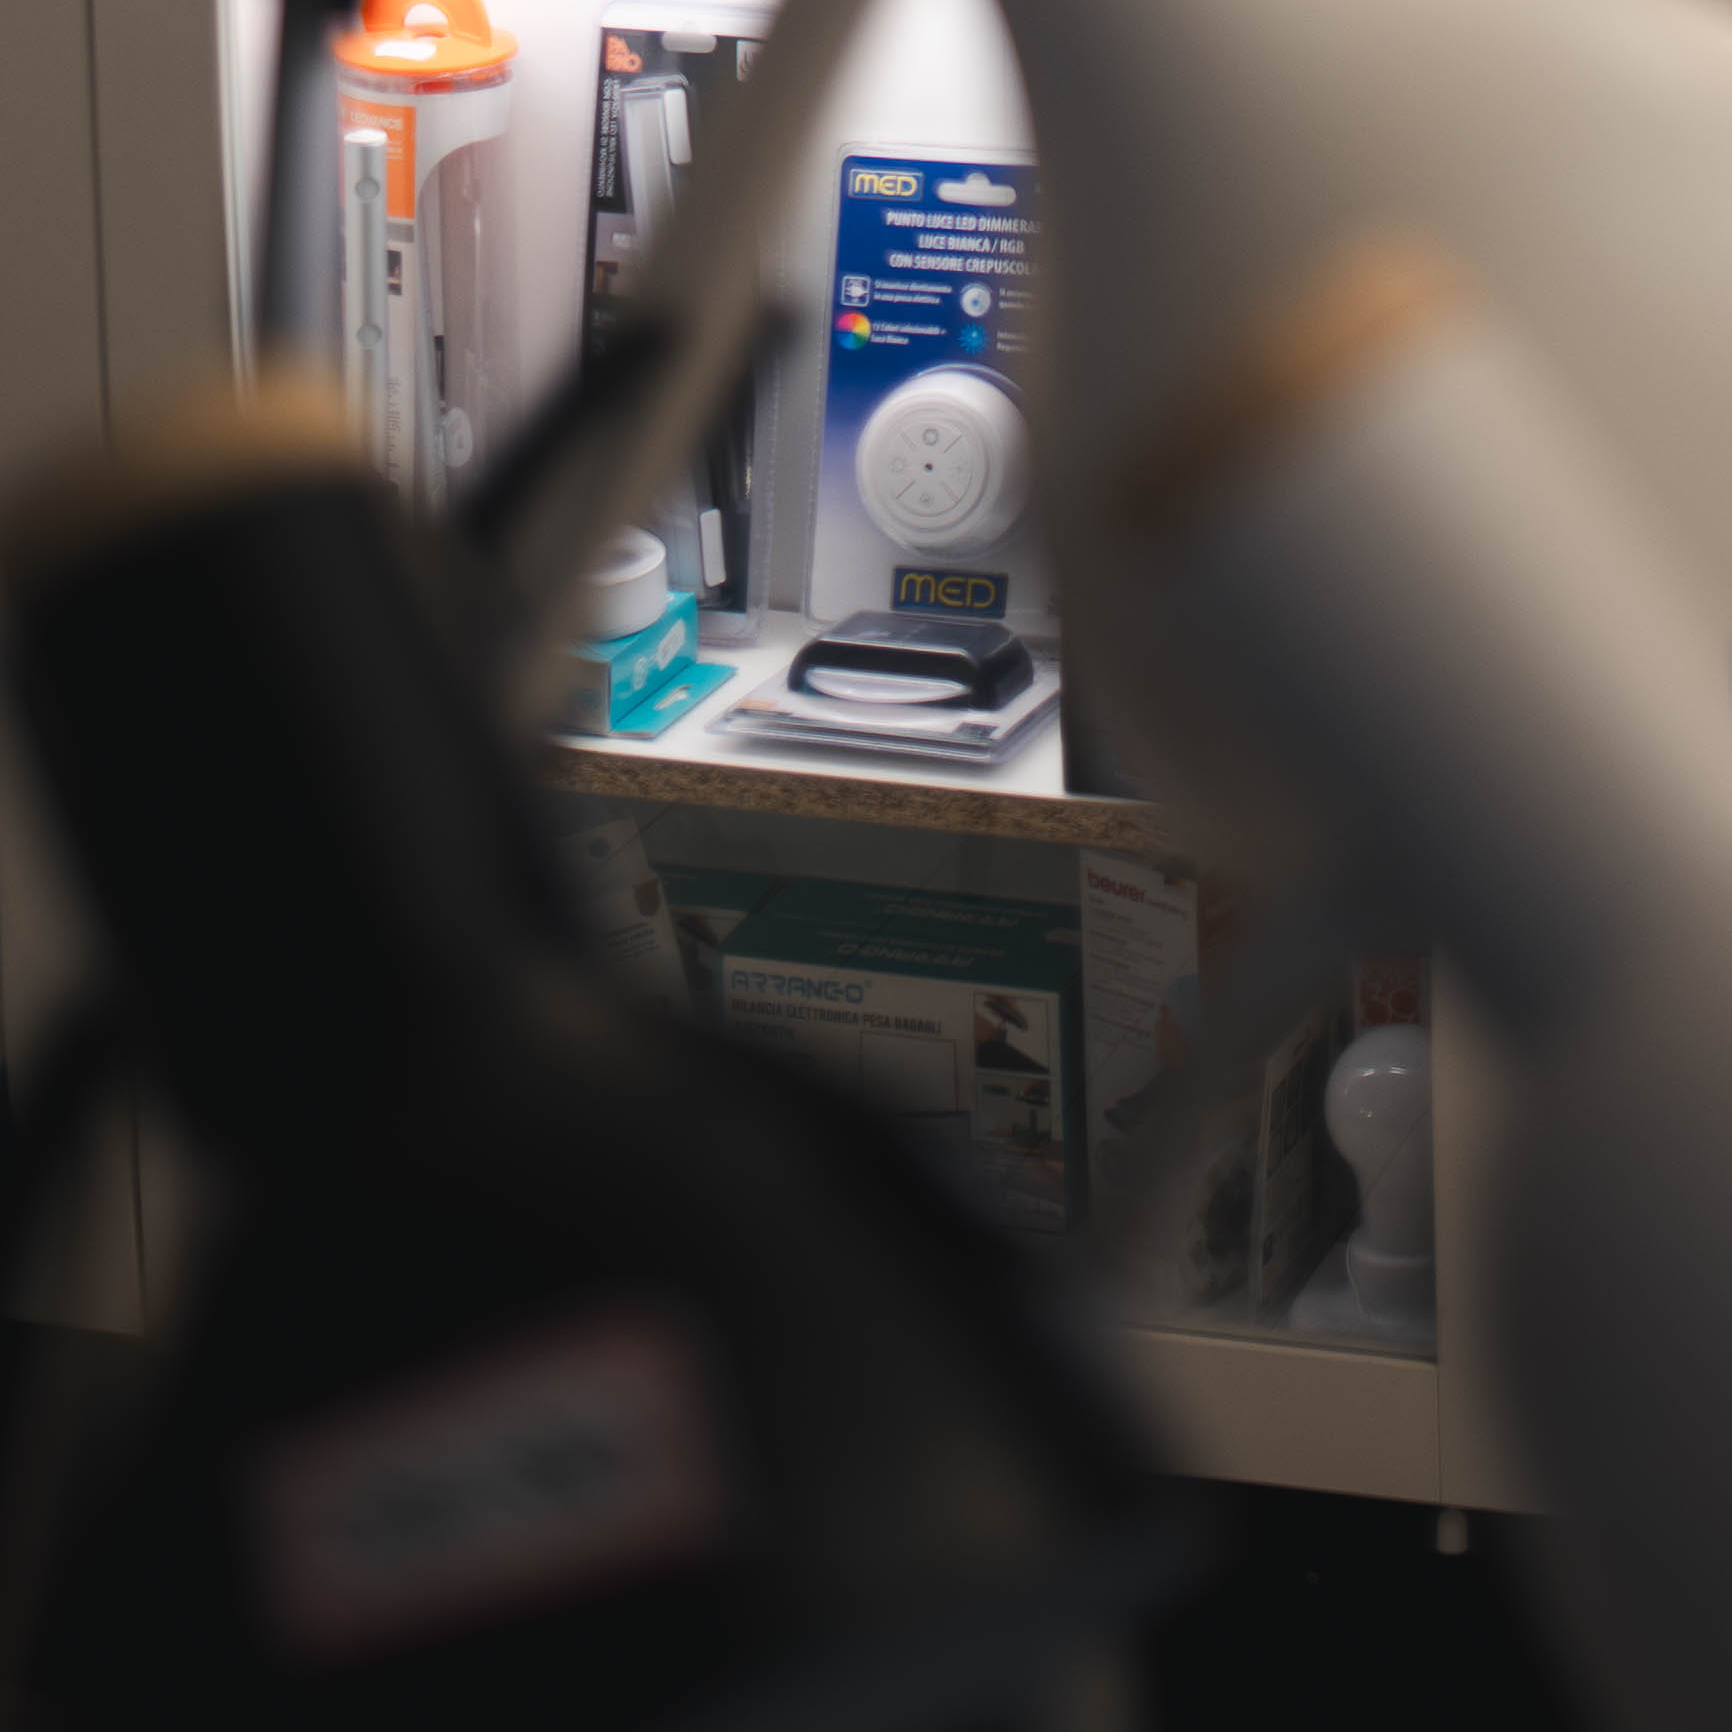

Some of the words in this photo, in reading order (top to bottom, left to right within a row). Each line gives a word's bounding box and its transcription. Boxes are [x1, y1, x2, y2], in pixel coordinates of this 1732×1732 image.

[854, 171, 918, 197] MED
[886, 211, 924, 227] PUNTO
[927, 213, 954, 228] LUCE
[955, 215, 976, 230] LED
[918, 235, 946, 250] LUCE
[948, 237, 990, 253] BIANCA
[999, 240, 1025, 255] RGB
[890, 253, 912, 268] CON
[914, 255, 963, 271] SENSORE
[966, 257, 1036, 276] CREPUSCOL
[900, 572, 996, 609] MED
[1087, 870, 1146, 904] beurer
